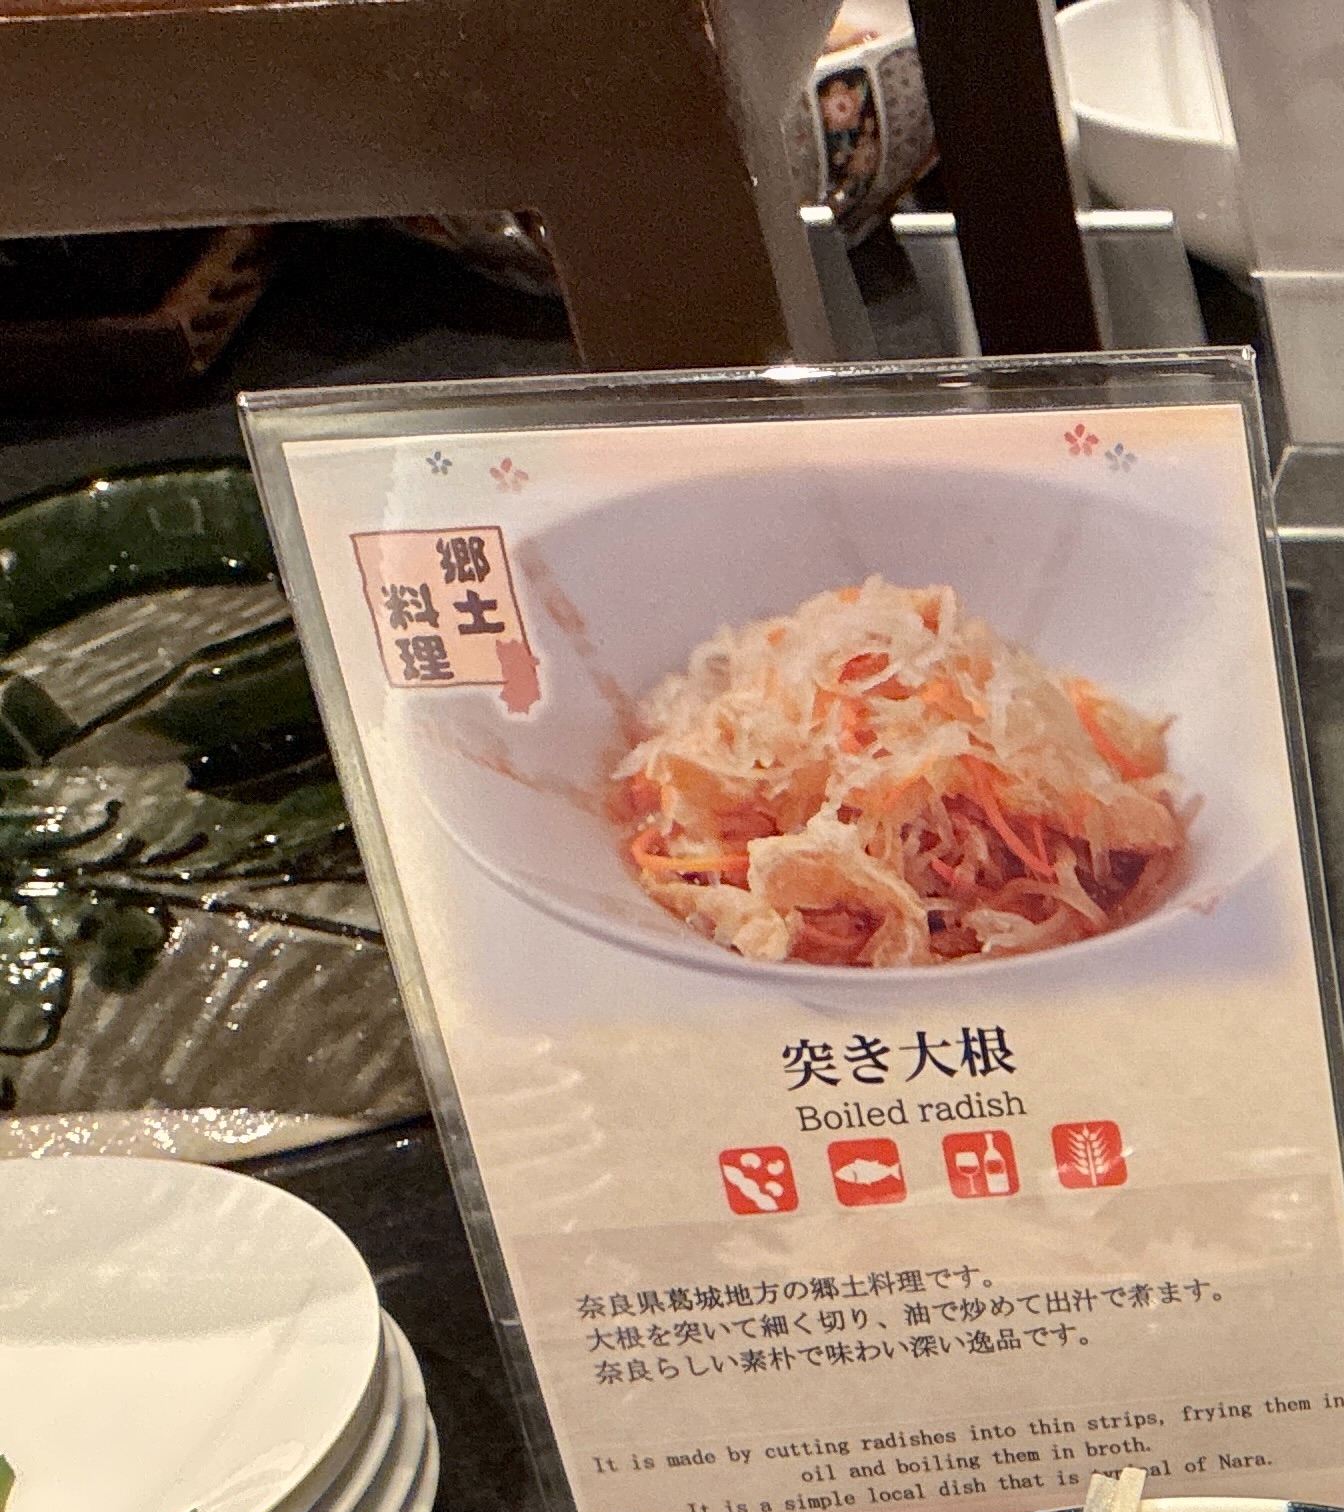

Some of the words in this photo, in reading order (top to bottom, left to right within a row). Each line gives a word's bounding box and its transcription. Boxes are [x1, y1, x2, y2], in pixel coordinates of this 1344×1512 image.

[435, 536, 506, 636] 郷土
[381, 583, 455, 681] 料理
[781, 1026, 1018, 1091] 突き大根
[798, 1096, 909, 1133] Boiled
[918, 1090, 1027, 1125] radish
[577, 1264, 994, 1320] 奈良県葛城地方の郷土料理です。
[586, 1278, 1223, 1352] 大根を突いて細く切り、油で炒めて出汁で煮ます。
[596, 1322, 1090, 1385] 奈良らしい素朴で味わい深い逸品です。
[594, 1456, 615, 1474] It
[631, 1452, 656, 1471] is
[667, 1447, 716, 1468] made
[727, 1445, 752, 1465] by
[765, 1438, 850, 1460] cutting
[861, 1428, 957, 1452] radishes
[970, 1424, 1016, 1442] into
[1029, 1417, 1076, 1435] thin
[1087, 1410, 1165, 1431] strips,
[1182, 1404, 1253, 1423] frying
[1265, 1397, 1312, 1414] them
[801, 1468, 837, 1484] oil
[849, 1460, 886, 1479] and
[897, 1452, 981, 1475] boiling
[992, 1447, 1040, 1465] them
[1051, 1444, 1076, 1461] in
[1085, 1437, 1152, 1457] broth.
[784, 1492, 856, 1512] simple
[868, 1484, 926, 1503] local
[939, 1477, 986, 1496] dish
[998, 1472, 1045, 1490] that
[1058, 1469, 1080, 1486] is
[1184, 1455, 1208, 1472] of
[1218, 1453, 1273, 1470] Nara.
